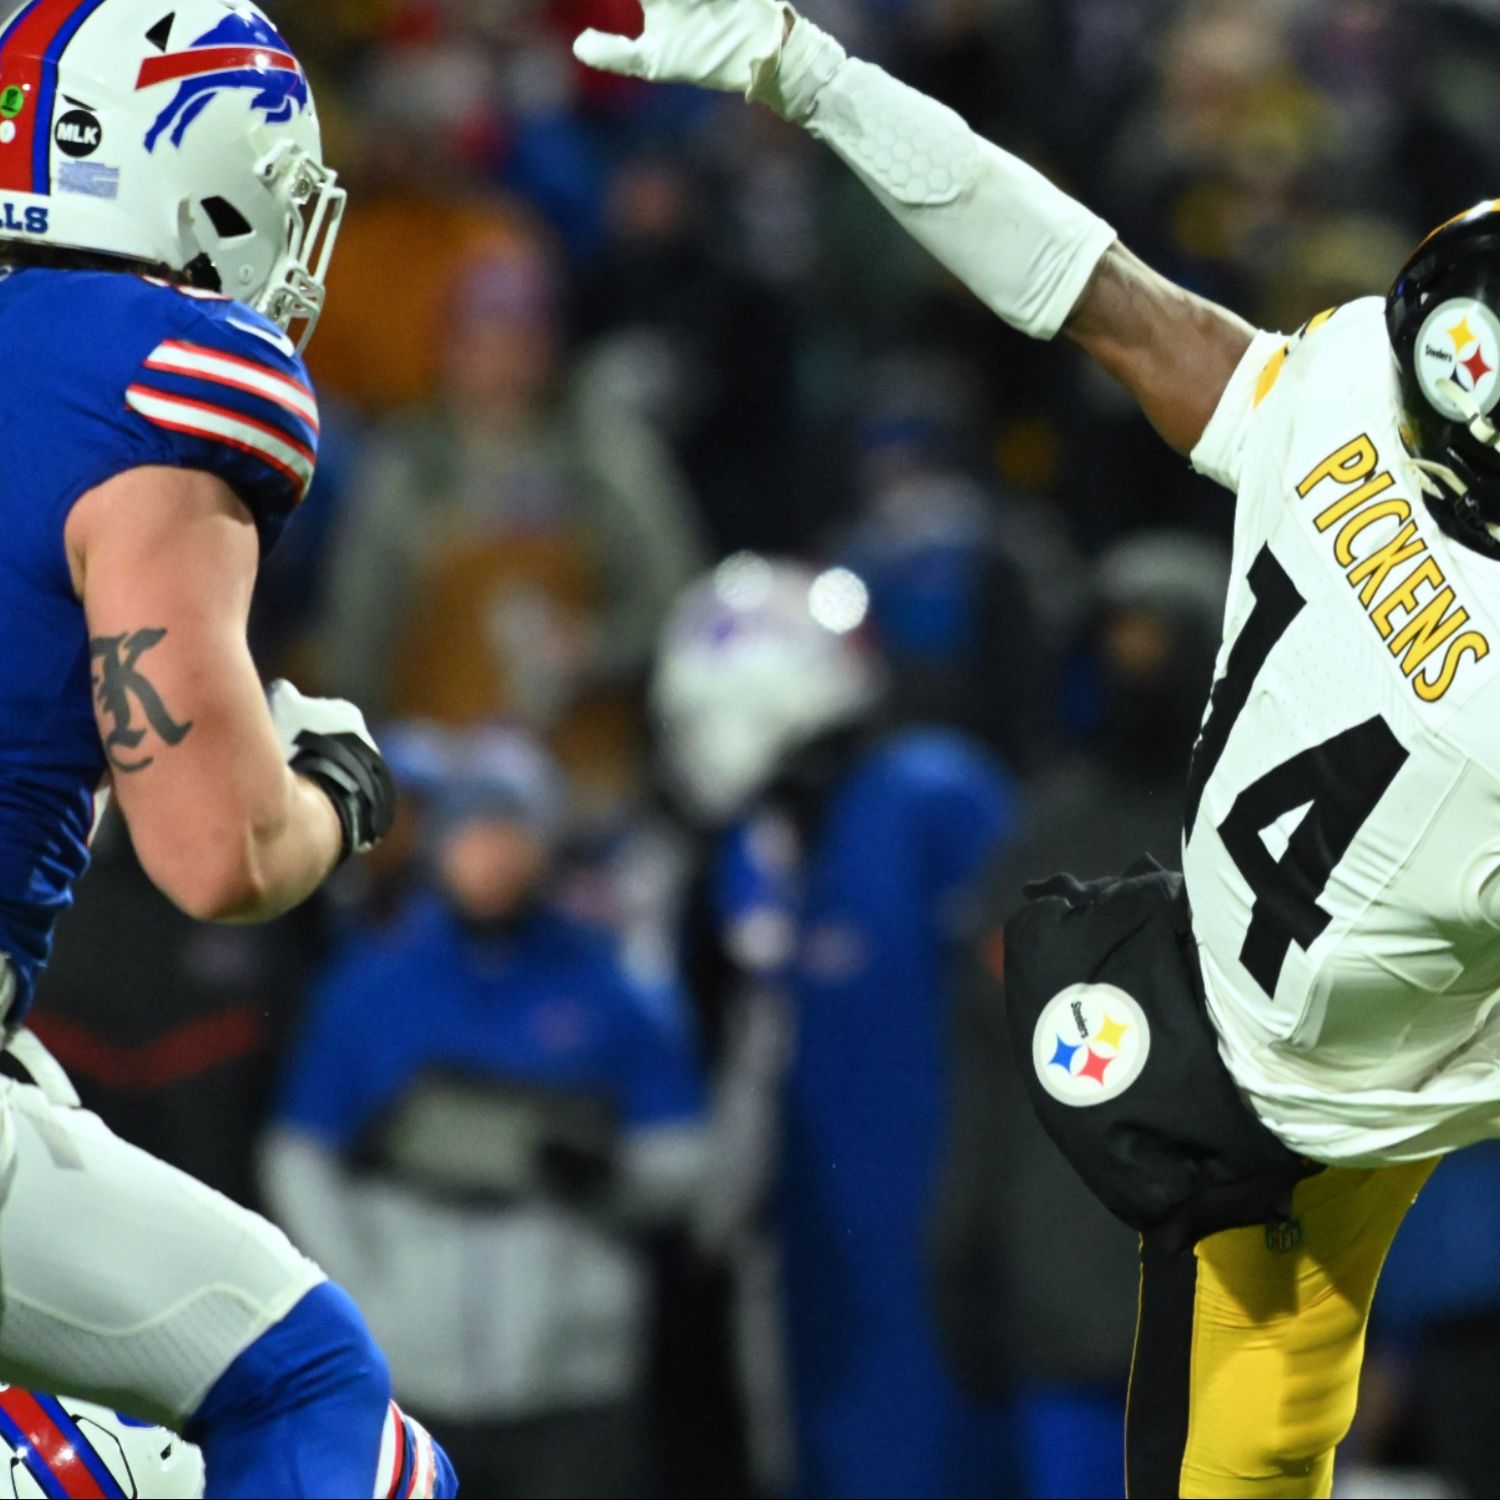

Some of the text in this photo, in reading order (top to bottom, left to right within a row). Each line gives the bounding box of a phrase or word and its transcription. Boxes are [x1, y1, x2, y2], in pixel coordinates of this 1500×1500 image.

[57, 122, 98, 145] MLK
[0, 203, 48, 234] LS
[1295, 432, 1491, 703] PICKENS
[1185, 540, 1411, 1001] 14
